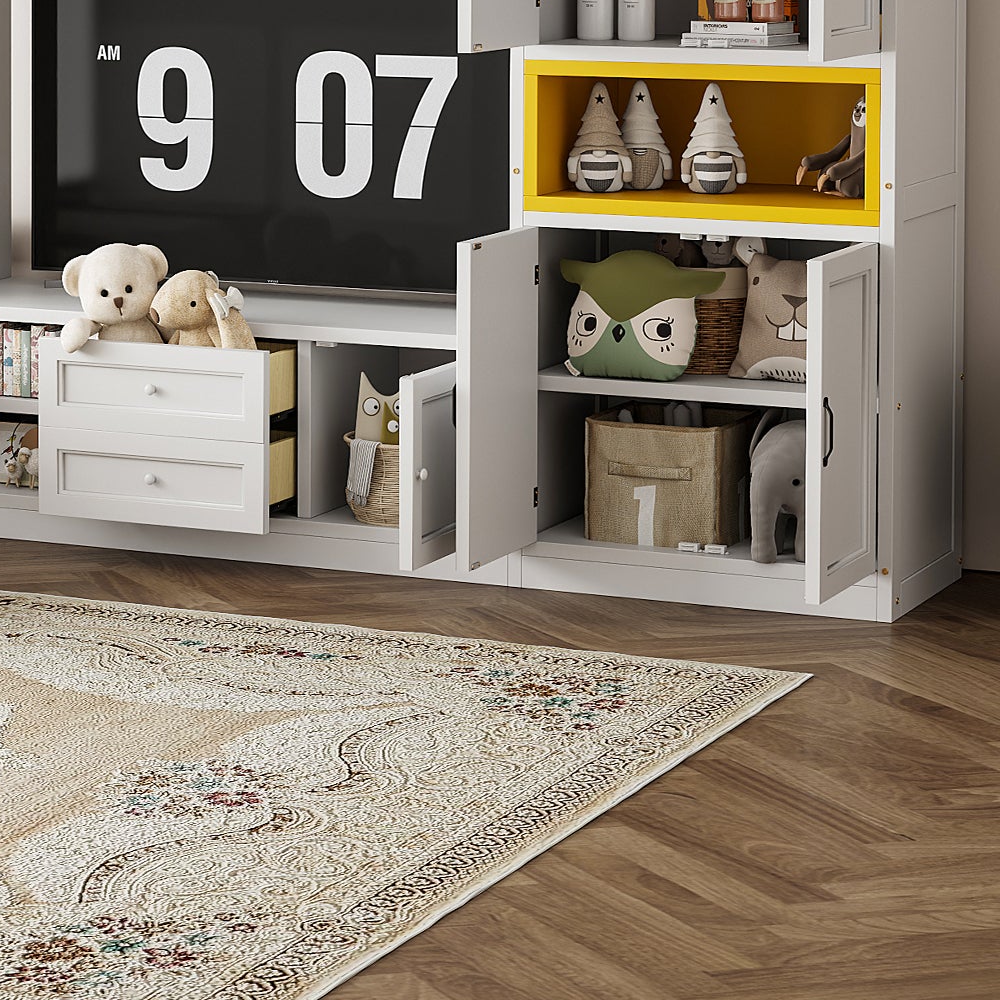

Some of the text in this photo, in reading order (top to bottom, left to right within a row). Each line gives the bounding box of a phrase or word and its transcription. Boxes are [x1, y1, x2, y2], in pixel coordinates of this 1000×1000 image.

[97, 44, 121, 61] AM
[137, 46, 459, 200] 9 07
[633, 485, 657, 547] 1
